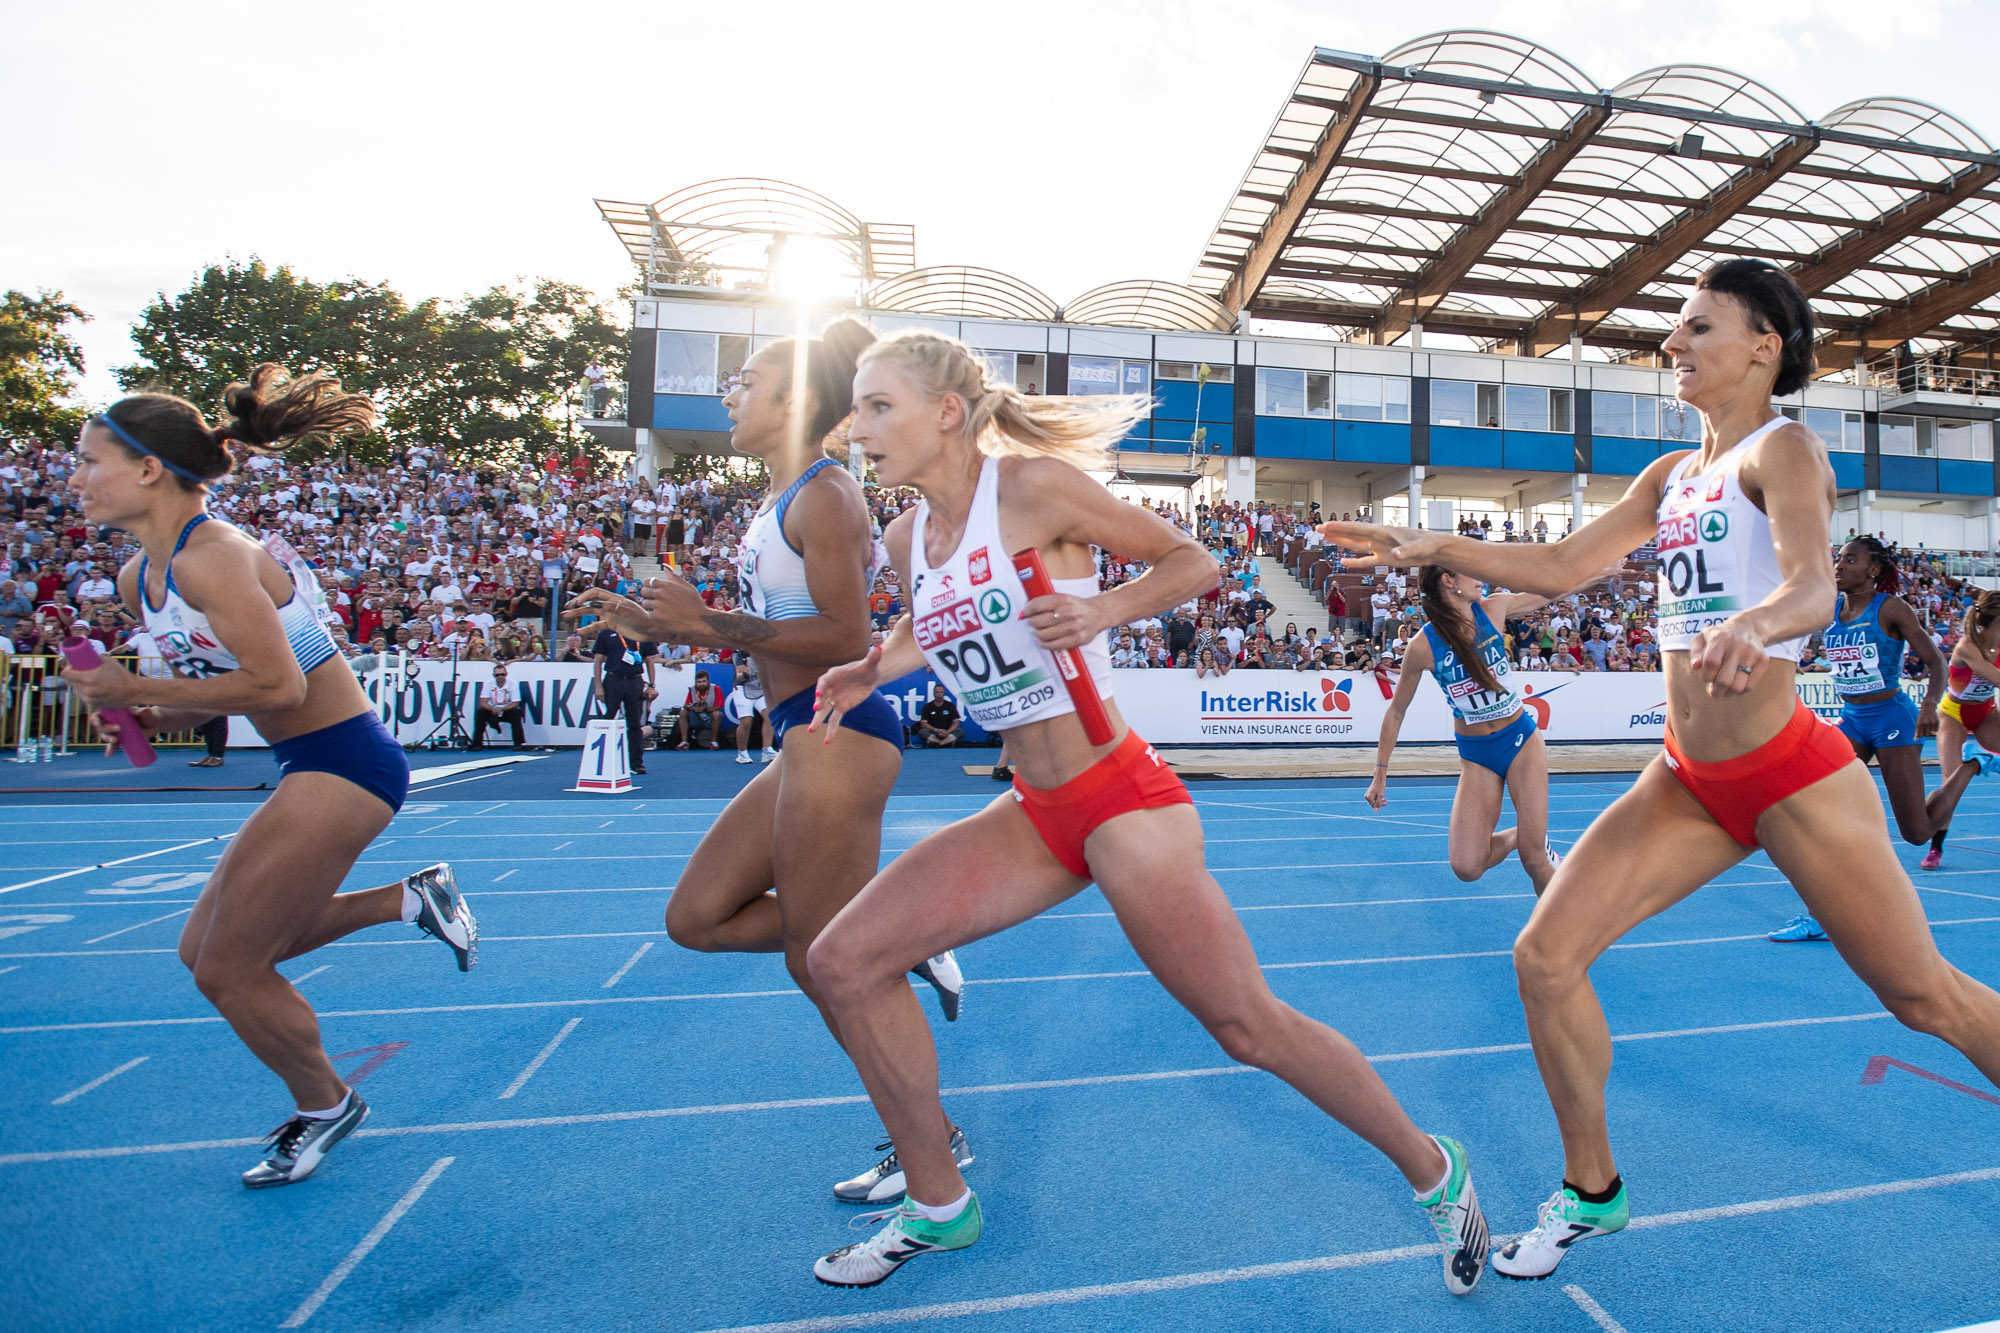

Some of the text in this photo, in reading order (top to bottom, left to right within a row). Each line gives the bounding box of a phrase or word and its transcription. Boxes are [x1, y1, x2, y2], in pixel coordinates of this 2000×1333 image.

[1657, 517, 1696, 548] PAR
[931, 590, 955, 607] ORLEN
[1661, 604, 1676, 616] RUN
[914, 603, 980, 646] SPAR
[1828, 648, 1861, 661] SPAR
[1836, 661, 1870, 678] ITA
[1018, 685, 1054, 711] 2019
[1201, 691, 1317, 712] InterRisk
[1468, 708, 1511, 722] BYDGOSZCZ
[1201, 724, 1353, 735] VIENNA INSURANCE GROUP
[591, 733, 606, 776] 1
[617, 733, 625, 775] 1
